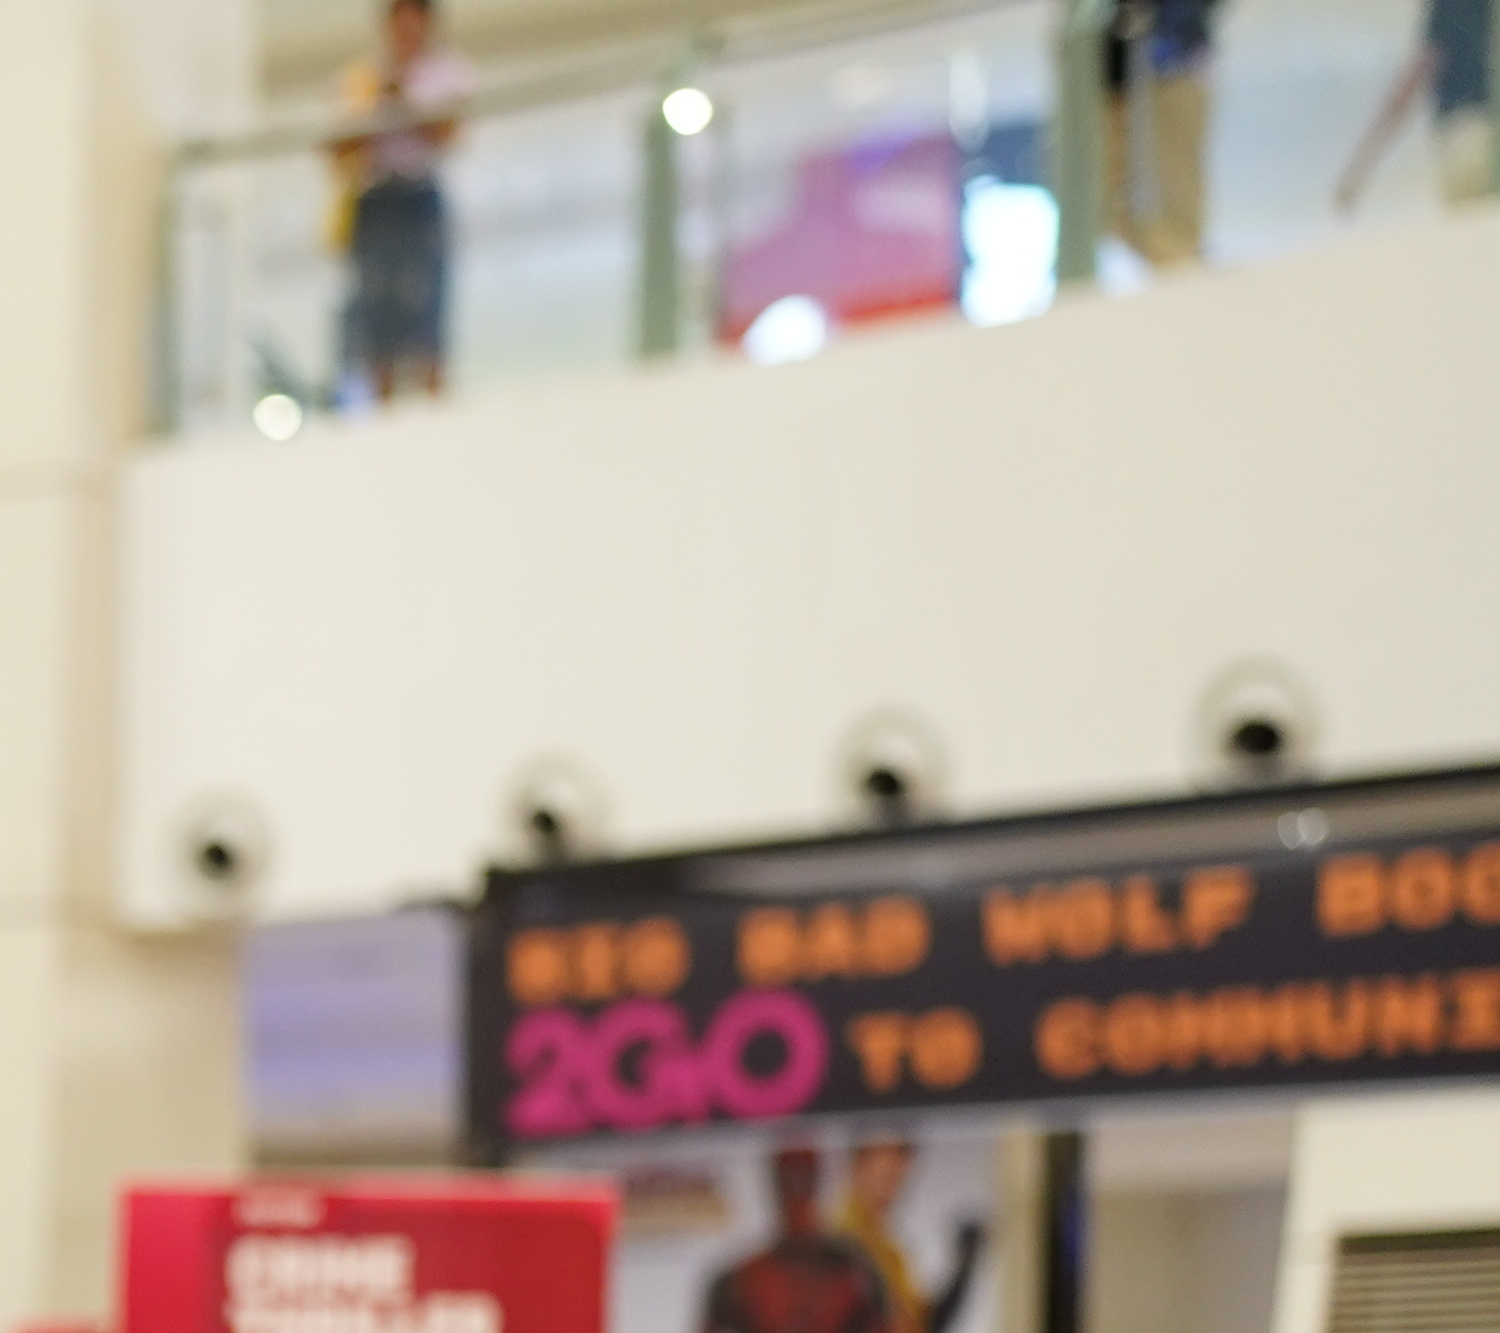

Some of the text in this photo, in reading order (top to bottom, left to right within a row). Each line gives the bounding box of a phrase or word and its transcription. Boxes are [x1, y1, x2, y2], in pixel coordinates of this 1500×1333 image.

[510, 916, 689, 1002] BIG
[736, 897, 932, 982] BAD
[982, 863, 1256, 965] WOLF
[510, 988, 830, 1138] 2GO
[850, 1003, 985, 1092] TO
